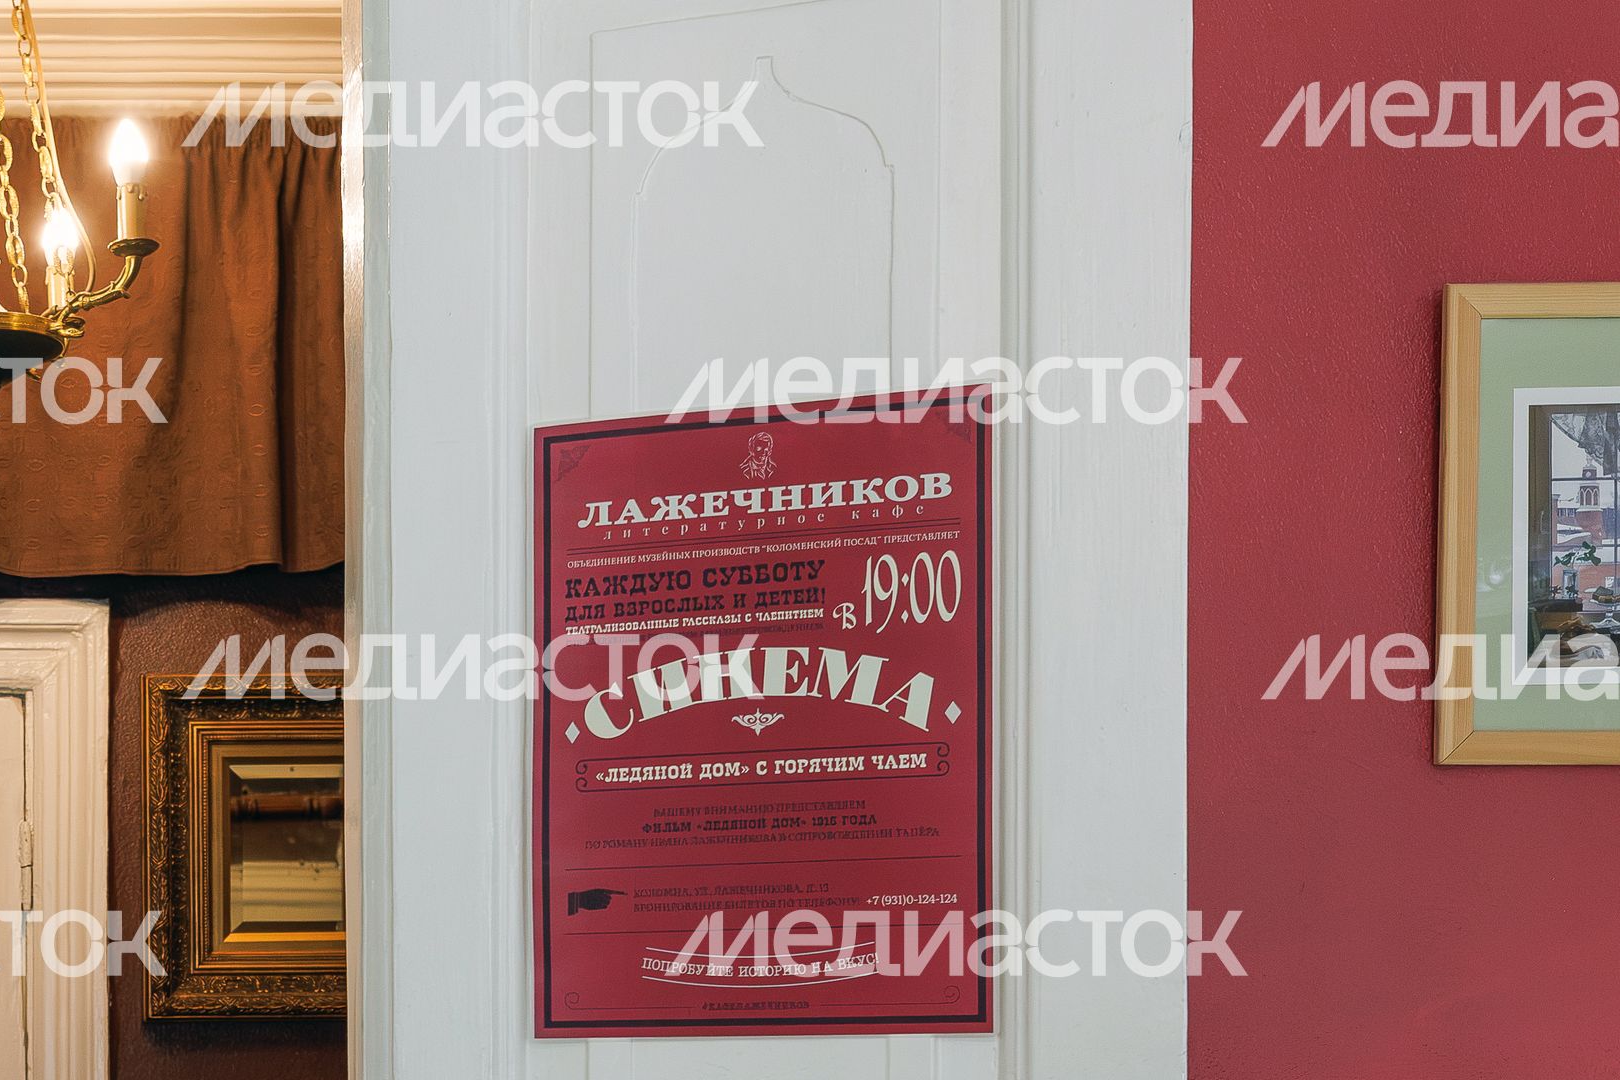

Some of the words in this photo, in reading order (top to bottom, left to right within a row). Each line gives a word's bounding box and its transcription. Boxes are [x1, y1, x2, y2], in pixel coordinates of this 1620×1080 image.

[577, 472, 953, 528] ЛАЖЕЧНИКОВ
[603, 512, 825, 540] литературное
[851, 504, 924, 520] кафе
[567, 555, 636, 569] ОБЪЕДИНЕНИЕ
[637, 551, 691, 563] МУЗЕЙНЫХ
[692, 545, 760, 559] ПРОИЗВОДСТВ
[883, 530, 960, 544] ПРЕДСТАВЛЯЕТ
[565, 570, 691, 598] КАЖДУЮ
[702, 560, 825, 588] СУББОТУ
[861, 550, 961, 633] 19:00
[565, 604, 605, 623] ДЛЯ
[614, 595, 724, 617] ВЗРОСЛЫХ
[733, 593, 746, 608] И
[755, 587, 826, 609] ДЕТЕЙ!
[566, 617, 679, 635] ТЕАТРАЛИЗОВАННЫЕ
[682, 613, 741, 626] РАССКАЗЫ
[745, 613, 752, 622] С
[755, 608, 824, 622] ЧАЕПИТИЕМ
[584, 646, 935, 739] СИНЕМА
[596, 763, 693, 783] «ЛЕДЯНОЙ
[699, 761, 750, 780] ДОМ»
[756, 761, 767, 775] С
[774, 756, 864, 775] ГОРЯЧИМ
[871, 753, 927, 770] ЧАЕМ
[642, 821, 691, 833] ФИЛЬМ
[842, 815, 877, 826] ГОДА
[866, 896, 879, 905] +7
[881, 894, 958, 907] (931)0-124-124
[641, 957, 733, 977] ПОПРОБУЙТЕ
[738, 964, 807, 977] ИСТОРИЮ
[811, 960, 833, 974] НА
[837, 952, 879, 970] ВКУС!
